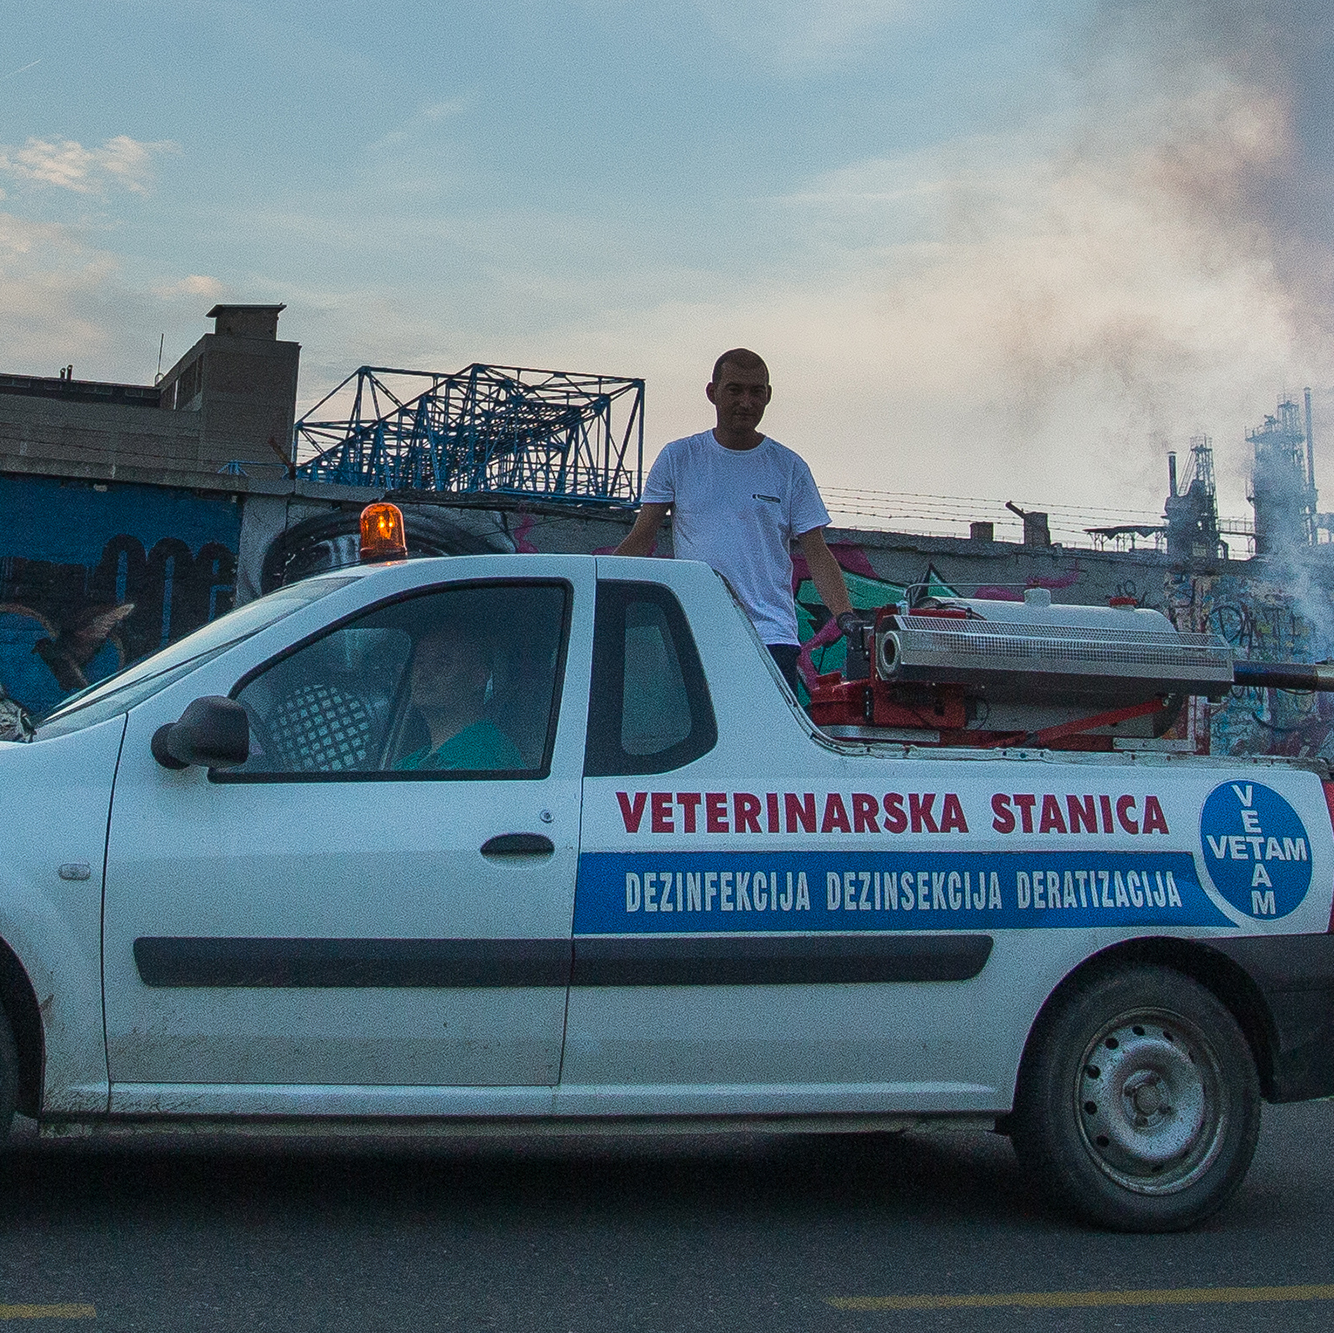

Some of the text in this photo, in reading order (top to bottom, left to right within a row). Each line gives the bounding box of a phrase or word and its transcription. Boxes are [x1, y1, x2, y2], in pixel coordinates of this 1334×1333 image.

[616, 791, 1170, 835] VETERINARSKA STANICA
[1205, 835, 1308, 861] VETAM
[1231, 784, 1277, 915] VETAM
[625, 870, 1183, 913] DEZINFEKCIJA DEZINSEKCIJA DERATIZACIJA
